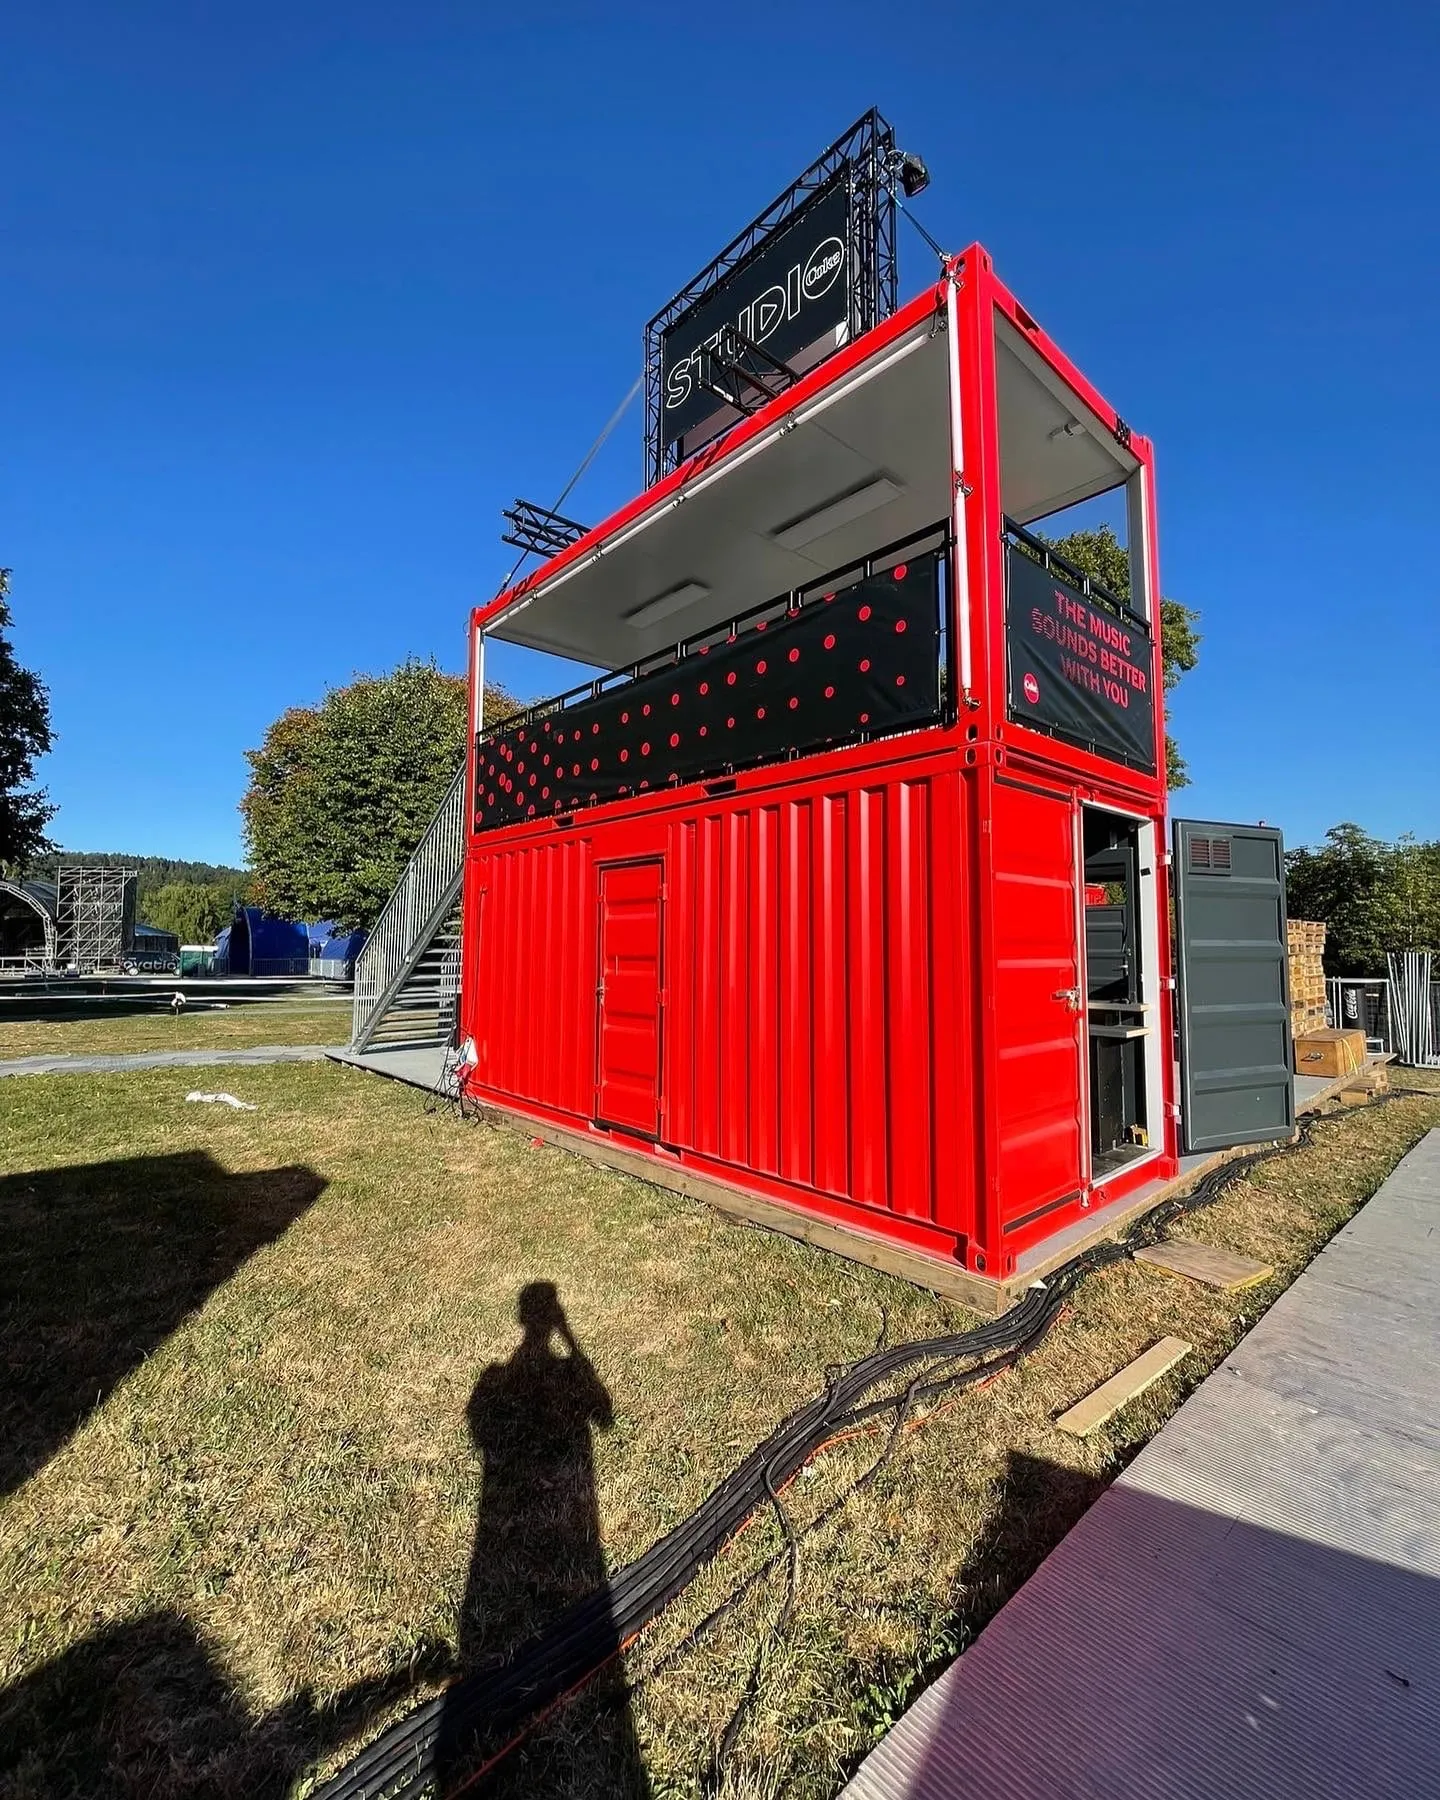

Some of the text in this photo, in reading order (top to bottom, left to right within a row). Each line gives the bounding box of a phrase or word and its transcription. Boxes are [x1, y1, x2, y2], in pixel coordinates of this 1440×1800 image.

[805, 250, 841, 287] Coke
[1031, 607, 1146, 693] SOUNDS BETTER
[1054, 589, 1131, 656] THE MUSIC
[1060, 653, 1129, 709] WITH YOU
